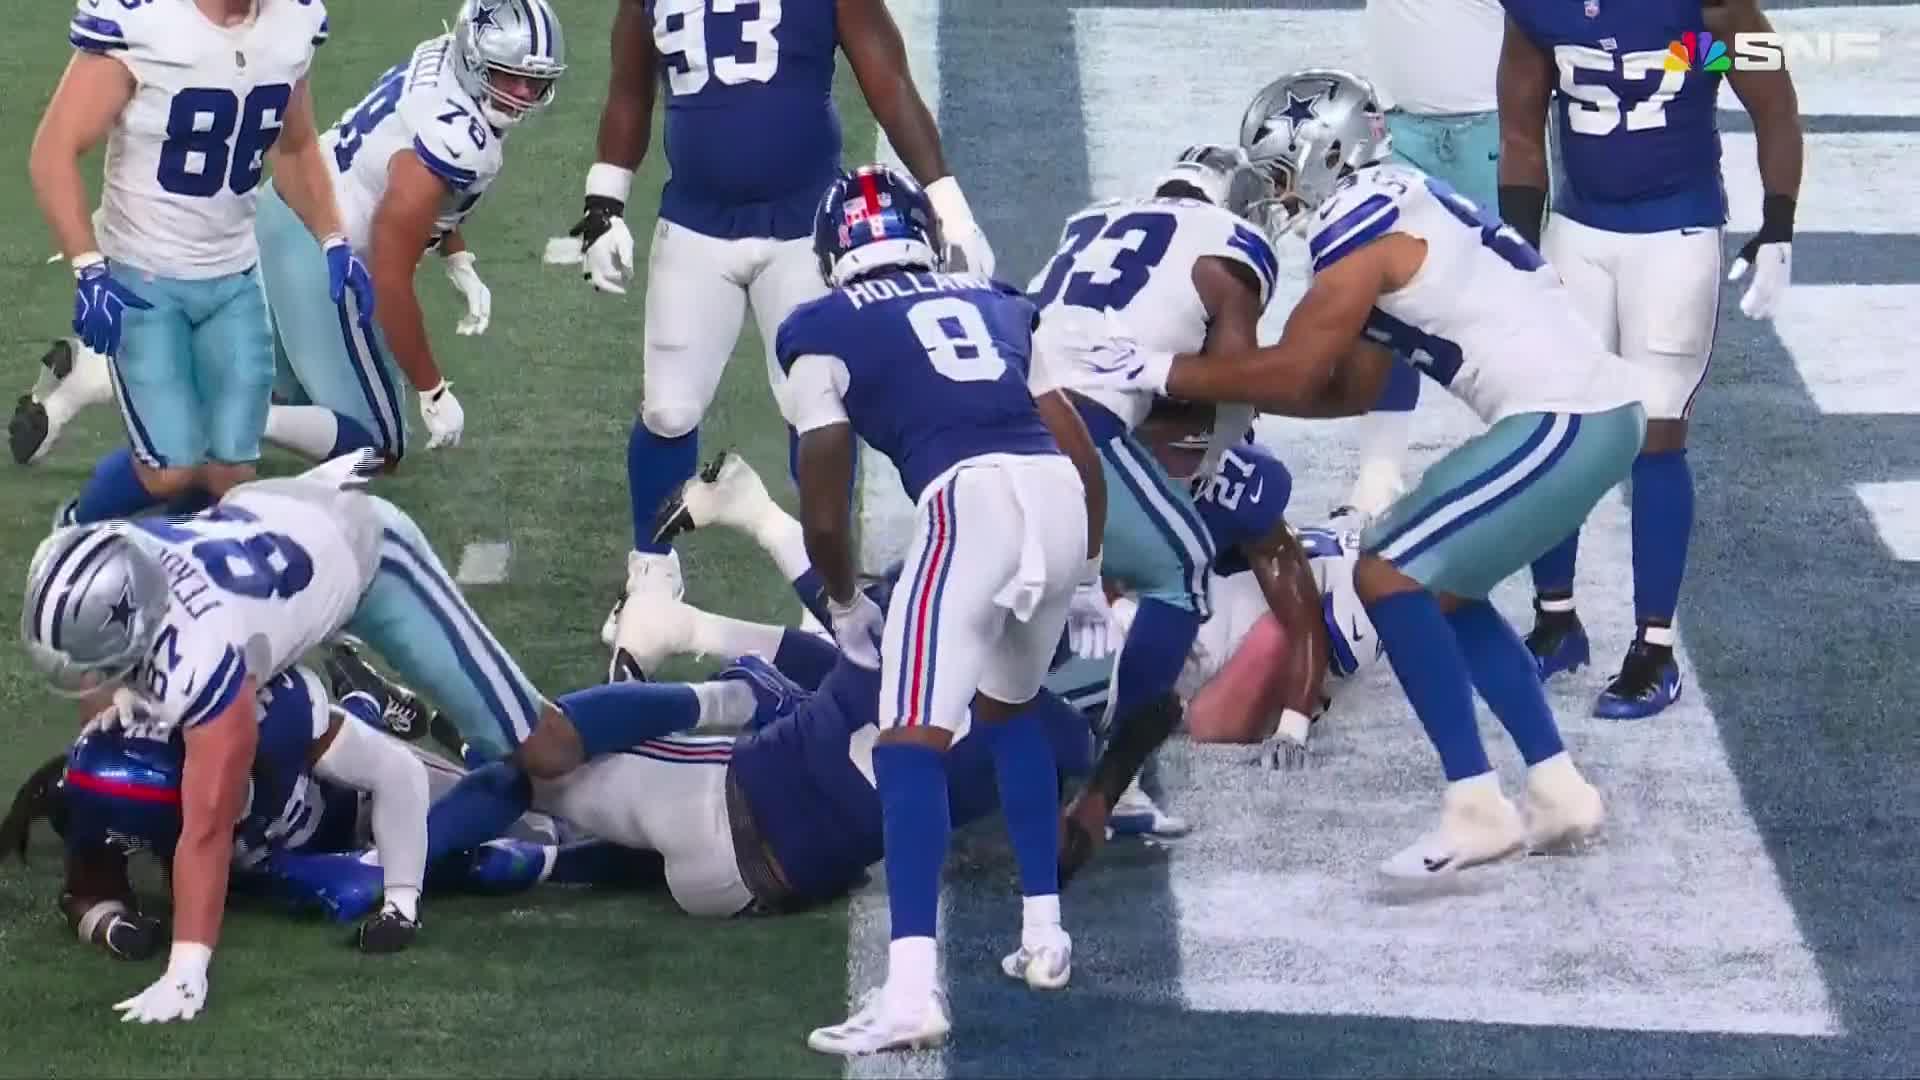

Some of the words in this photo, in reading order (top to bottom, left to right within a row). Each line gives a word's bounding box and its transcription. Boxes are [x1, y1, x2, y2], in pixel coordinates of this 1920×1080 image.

[653, 0, 782, 96] 93
[1553, 45, 1685, 136] 57
[157, 83, 292, 197] 86
[842, 271, 1003, 311] HOLLAN
[906, 297, 1007, 382] 8
